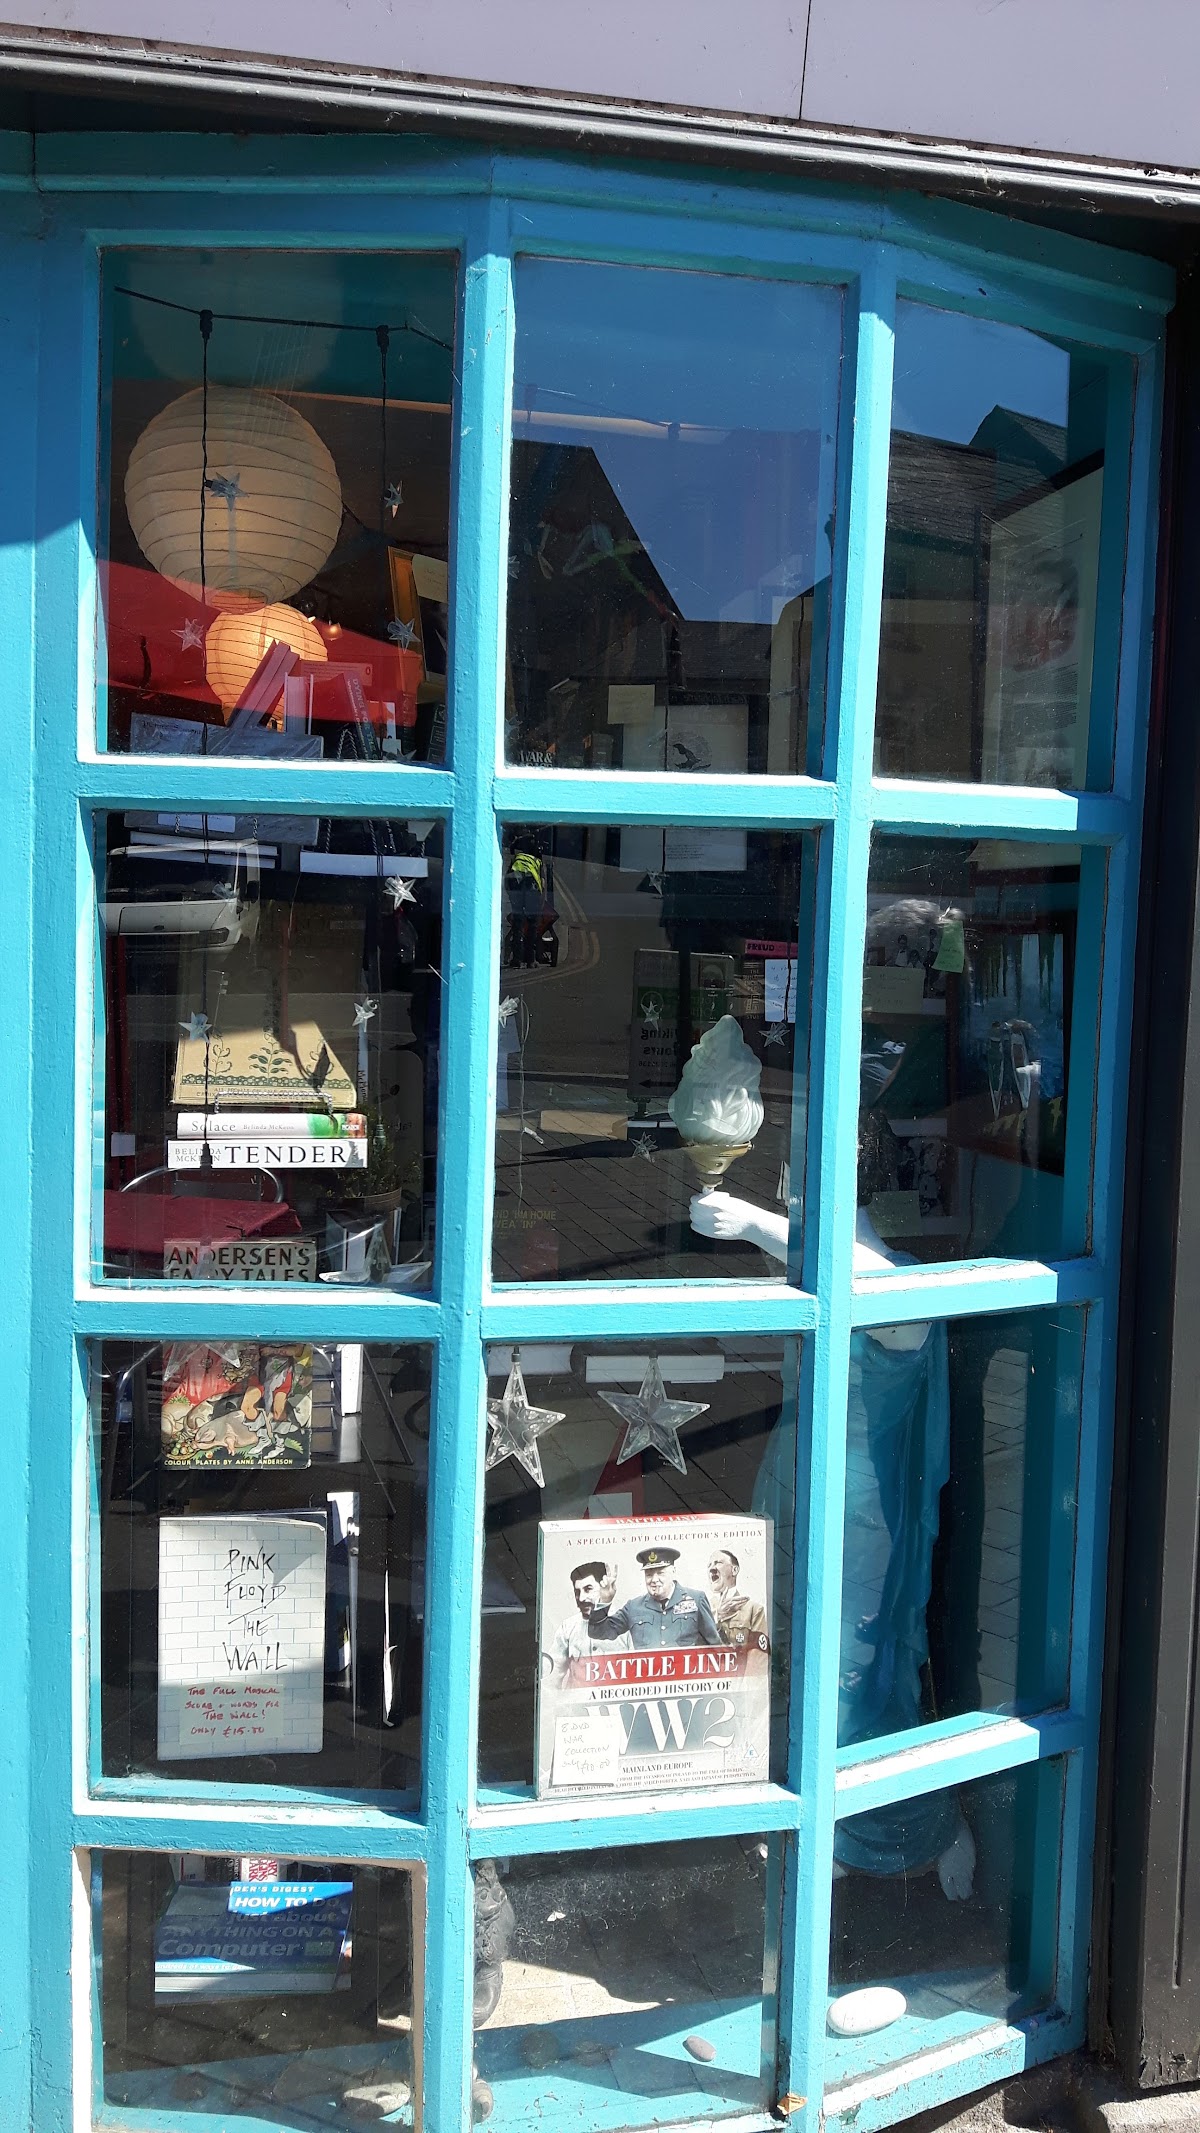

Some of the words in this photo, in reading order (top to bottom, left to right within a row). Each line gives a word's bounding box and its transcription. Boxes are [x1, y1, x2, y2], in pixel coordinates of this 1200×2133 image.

[747, 943, 775, 952] FREUD
[191, 1120, 236, 1132] Solace
[224, 1146, 347, 1164] TENDER
[566, 1539, 572, 1547] A
[576, 1536, 618, 1546] SPECIAL
[631, 1534, 650, 1543] DVD
[654, 1531, 719, 1542] COLLECTOR'S
[723, 1529, 763, 1539] EDITION
[223, 1545, 276, 1578] PINK
[223, 1573, 287, 1609] FLOYD
[228, 1606, 275, 1639] THE
[222, 1641, 288, 1671] WALL
[584, 1655, 676, 1683] BATTLE
[682, 1651, 739, 1675] LINE
[187, 1686, 206, 1696] THE
[213, 1686, 237, 1695] FULL
[589, 1690, 597, 1701] A
[599, 1685, 661, 1700] RECORDED
[664, 1681, 715, 1695] HISTORY
[716, 1680, 732, 1691] OF
[202, 1709, 224, 1720] THE
[571, 1721, 590, 1730] DVD
[563, 1735, 584, 1744] WAR
[622, 1764, 662, 1774] MAINLAND
[664, 1761, 694, 1770] EUROPE
[267, 1859, 278, 1877] ARY
[272, 1885, 315, 1893] DIGEST
[234, 1897, 281, 1908] HOW
[284, 1897, 308, 1908] TO
[312, 1897, 341, 1907] DO
[273, 1911, 338, 1922] about
[282, 1926, 314, 1938] ON
[319, 1926, 333, 1938] A
[158, 1939, 301, 1960] Computer
